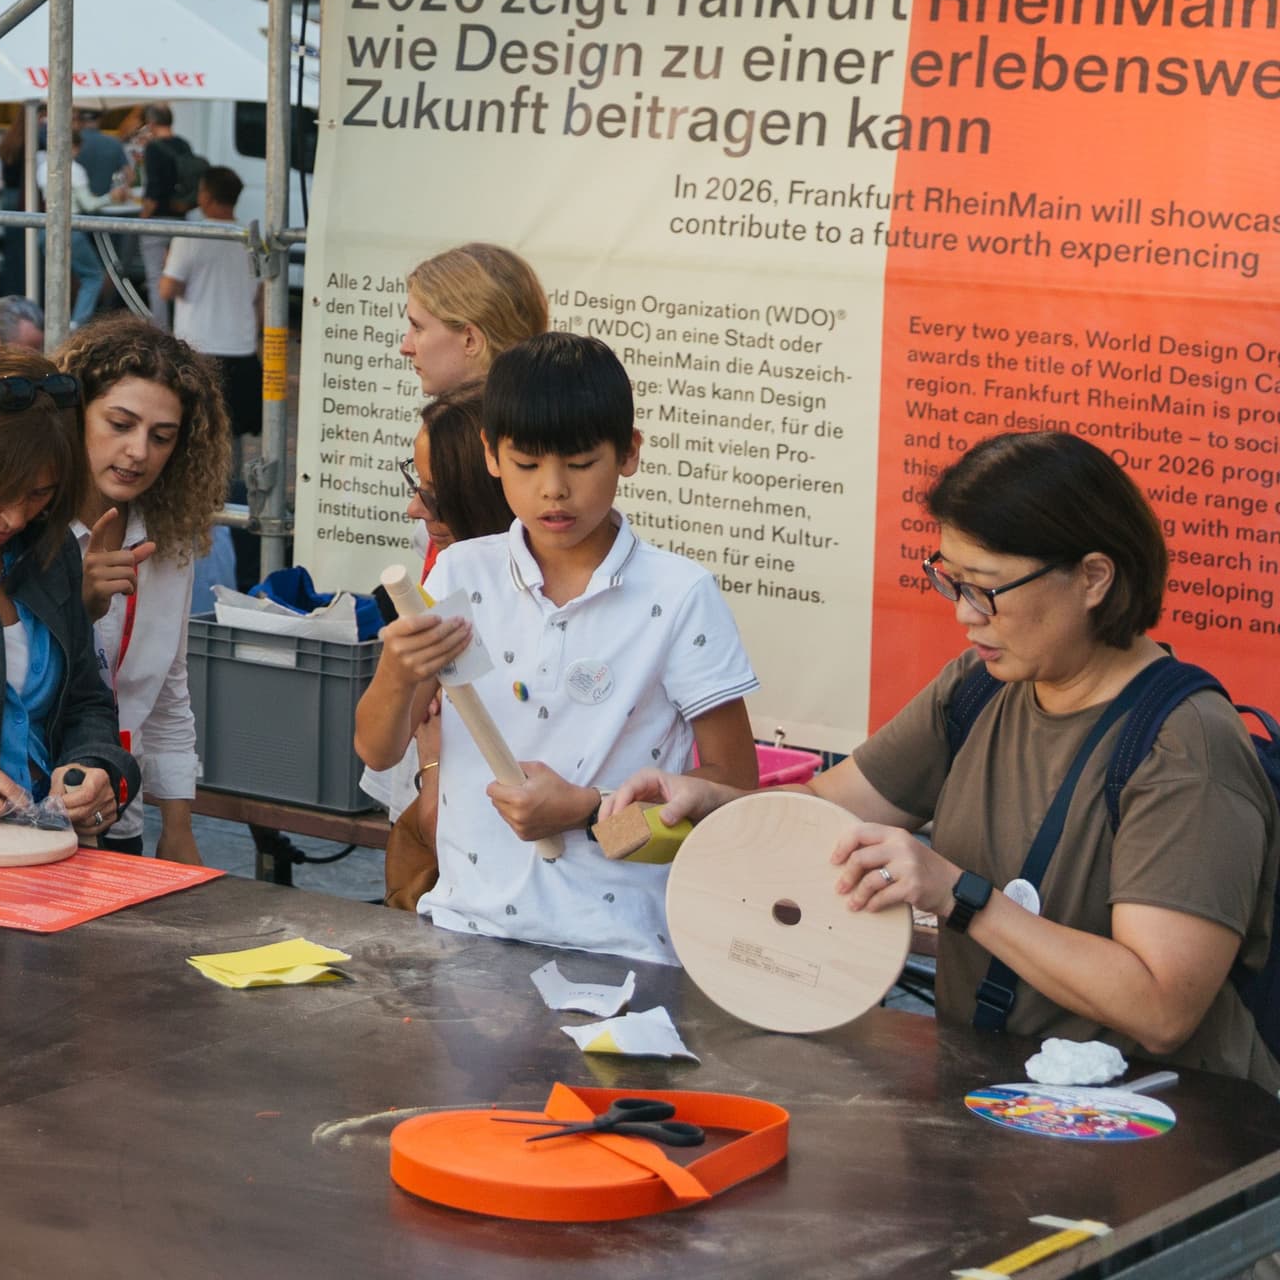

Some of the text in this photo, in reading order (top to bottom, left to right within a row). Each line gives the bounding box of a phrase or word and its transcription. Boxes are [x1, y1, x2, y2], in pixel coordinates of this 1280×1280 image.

[348, 23, 1280, 102] wie Design zu einer erlebenswe
[342, 78, 991, 158] Zukunft beitragen kann
[674, 174, 1280, 235] In 2026, Frankfurt RheinMain will showcas
[669, 214, 1260, 279] contribute to a future worth experiencing
[327, 272, 358, 291] Alle
[362, 275, 372, 291] 2
[326, 298, 355, 315] den
[359, 300, 393, 318] Titel
[575, 291, 636, 314] Design
[642, 295, 760, 321] Organization
[325, 324, 358, 340] eine
[587, 318, 651, 342] (WDC)
[656, 327, 677, 341] an
[682, 328, 720, 345] eine
[725, 329, 774, 350] Stadt
[780, 336, 823, 354] oder
[909, 316, 966, 342] Every
[972, 323, 1009, 341] two
[1016, 329, 1078, 348] years,
[1086, 330, 1151, 353] World
[1159, 335, 1238, 364] Design
[324, 352, 416, 371] nung erhalt
[623, 348, 853, 384] RheinMain die Auszeich-
[907, 349, 980, 368] awards
[987, 352, 1018, 370] the
[1025, 355, 1064, 374] title
[1071, 359, 1092, 377] of
[1098, 360, 1162, 383] World
[1170, 366, 1247, 394] Design
[323, 373, 418, 396] leisten für
[667, 378, 706, 399] Was
[712, 382, 754, 402] kann
[760, 387, 826, 413] Design
[906, 376, 976, 396] region.
[984, 379, 1080, 406] Frankfurt
[1088, 388, 1205, 417] RheinMain
[1213, 400, 1230, 419] is
[322, 397, 421, 423] Demokratie?
[659, 405, 775, 434] Miteinander,
[781, 416, 808, 436] für
[814, 420, 844, 439] die
[321, 424, 415, 447] jekten Antw
[906, 400, 1280, 455] What can design contribute to soci
[320, 450, 346, 465] wir
[349, 453, 373, 469] mit
[650, 433, 816, 464] soll mit vielen Pro-
[904, 432, 1280, 489] and to Our 2026 prog
[320, 473, 416, 498] Hochschule
[678, 460, 728, 482] Dafür
[732, 467, 844, 494] kooperieren
[904, 457, 1268, 516] this wide range
[318, 499, 416, 524] institutione
[615, 485, 810, 519] ativen, Unternehmen,
[317, 526, 414, 549] erlebenswe
[626, 511, 839, 549] stitutionen und Kultur-
[1182, 518, 1228, 538] with
[1236, 526, 1280, 544] man
[668, 540, 717, 562] Ideen
[723, 549, 749, 566] für
[755, 554, 795, 571] eine
[1167, 549, 1251, 572] esearch
[757, 579, 825, 603] hinaus.
[1167, 577, 1273, 609] eveloping
[1173, 609, 1242, 630] region
